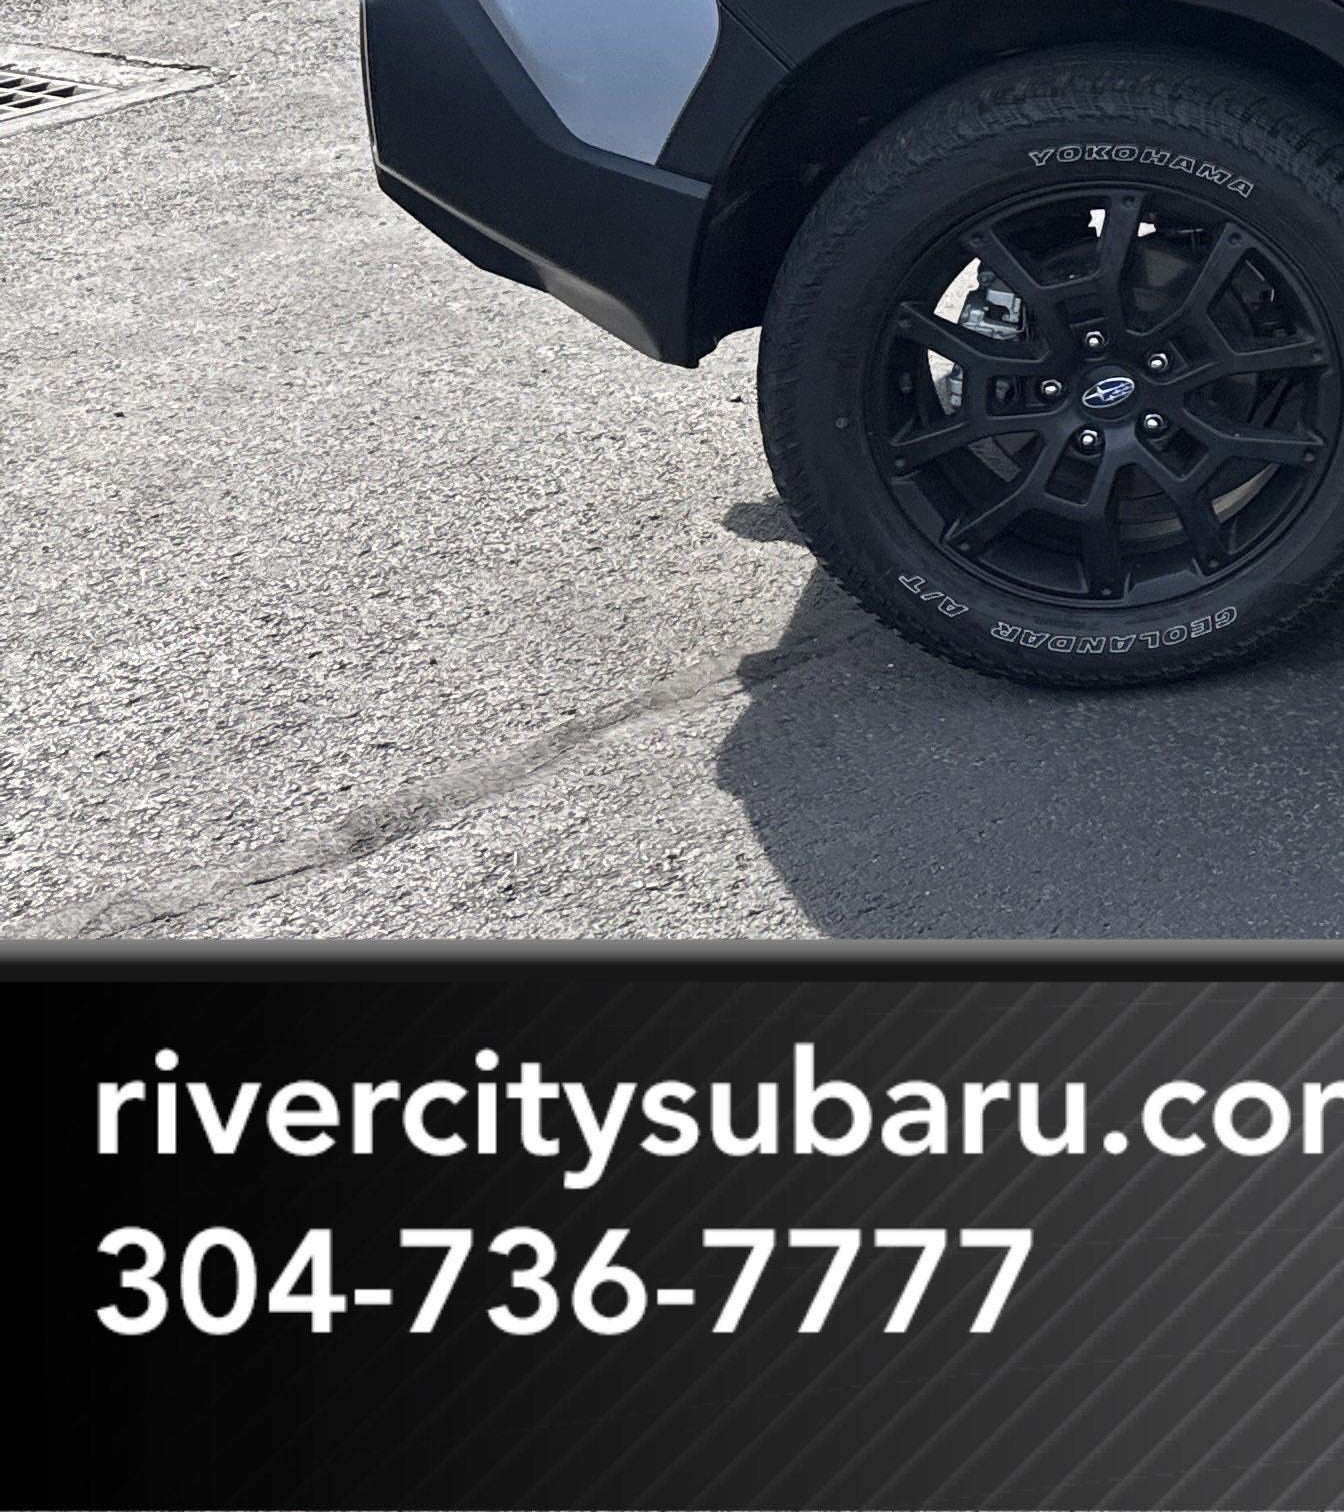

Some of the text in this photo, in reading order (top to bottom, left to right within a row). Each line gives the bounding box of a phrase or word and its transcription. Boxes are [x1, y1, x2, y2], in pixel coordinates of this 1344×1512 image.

[1028, 144, 1255, 199] YOKOHAMA
[897, 574, 1238, 654] GEOLANDAR A/T
